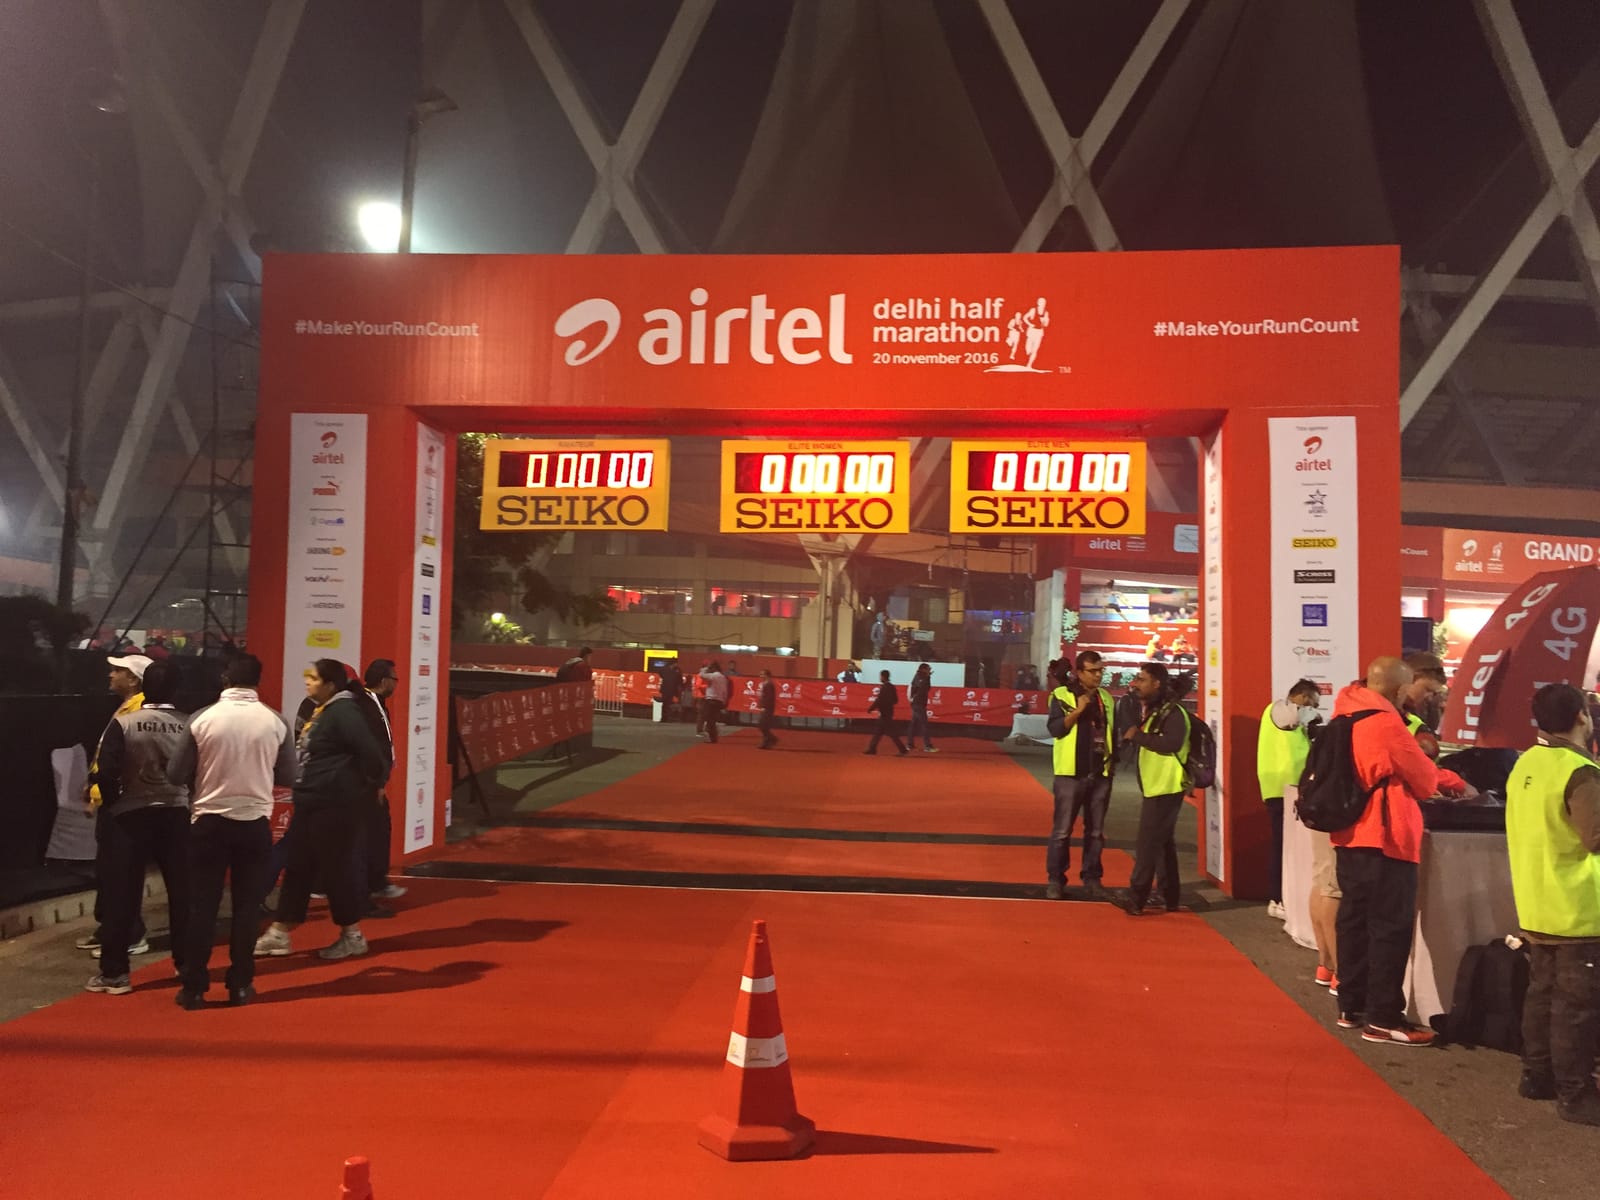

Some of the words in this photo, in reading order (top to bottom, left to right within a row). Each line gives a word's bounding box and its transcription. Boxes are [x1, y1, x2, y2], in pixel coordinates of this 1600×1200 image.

[873, 298, 941, 320] delhi
[950, 297, 1005, 319] half
[295, 319, 480, 337] #MakeYourRunCount
[638, 287, 853, 365] airtel
[873, 321, 1000, 343] marathon
[1153, 317, 1360, 337] #MakeYourRunCount
[873, 352, 891, 364] 20
[892, 352, 961, 365] november
[964, 352, 999, 364] 2016
[1058, 366, 1071, 374] TM
[312, 452, 344, 464] airtel
[1295, 458, 1331, 471] airtel
[497, 494, 649, 526] SEIKO
[736, 497, 893, 529] SEIKO
[967, 496, 1129, 529] SEIKO
[1089, 538, 1121, 550] airtel
[1293, 538, 1336, 548] SEIKO
[1524, 540, 1593, 563] GRAND
[1455, 560, 1483, 573] airtel
[1543, 607, 1587, 661] 4G
[1457, 649, 1503, 740] irtel
[137, 721, 184, 734] IGIANS
